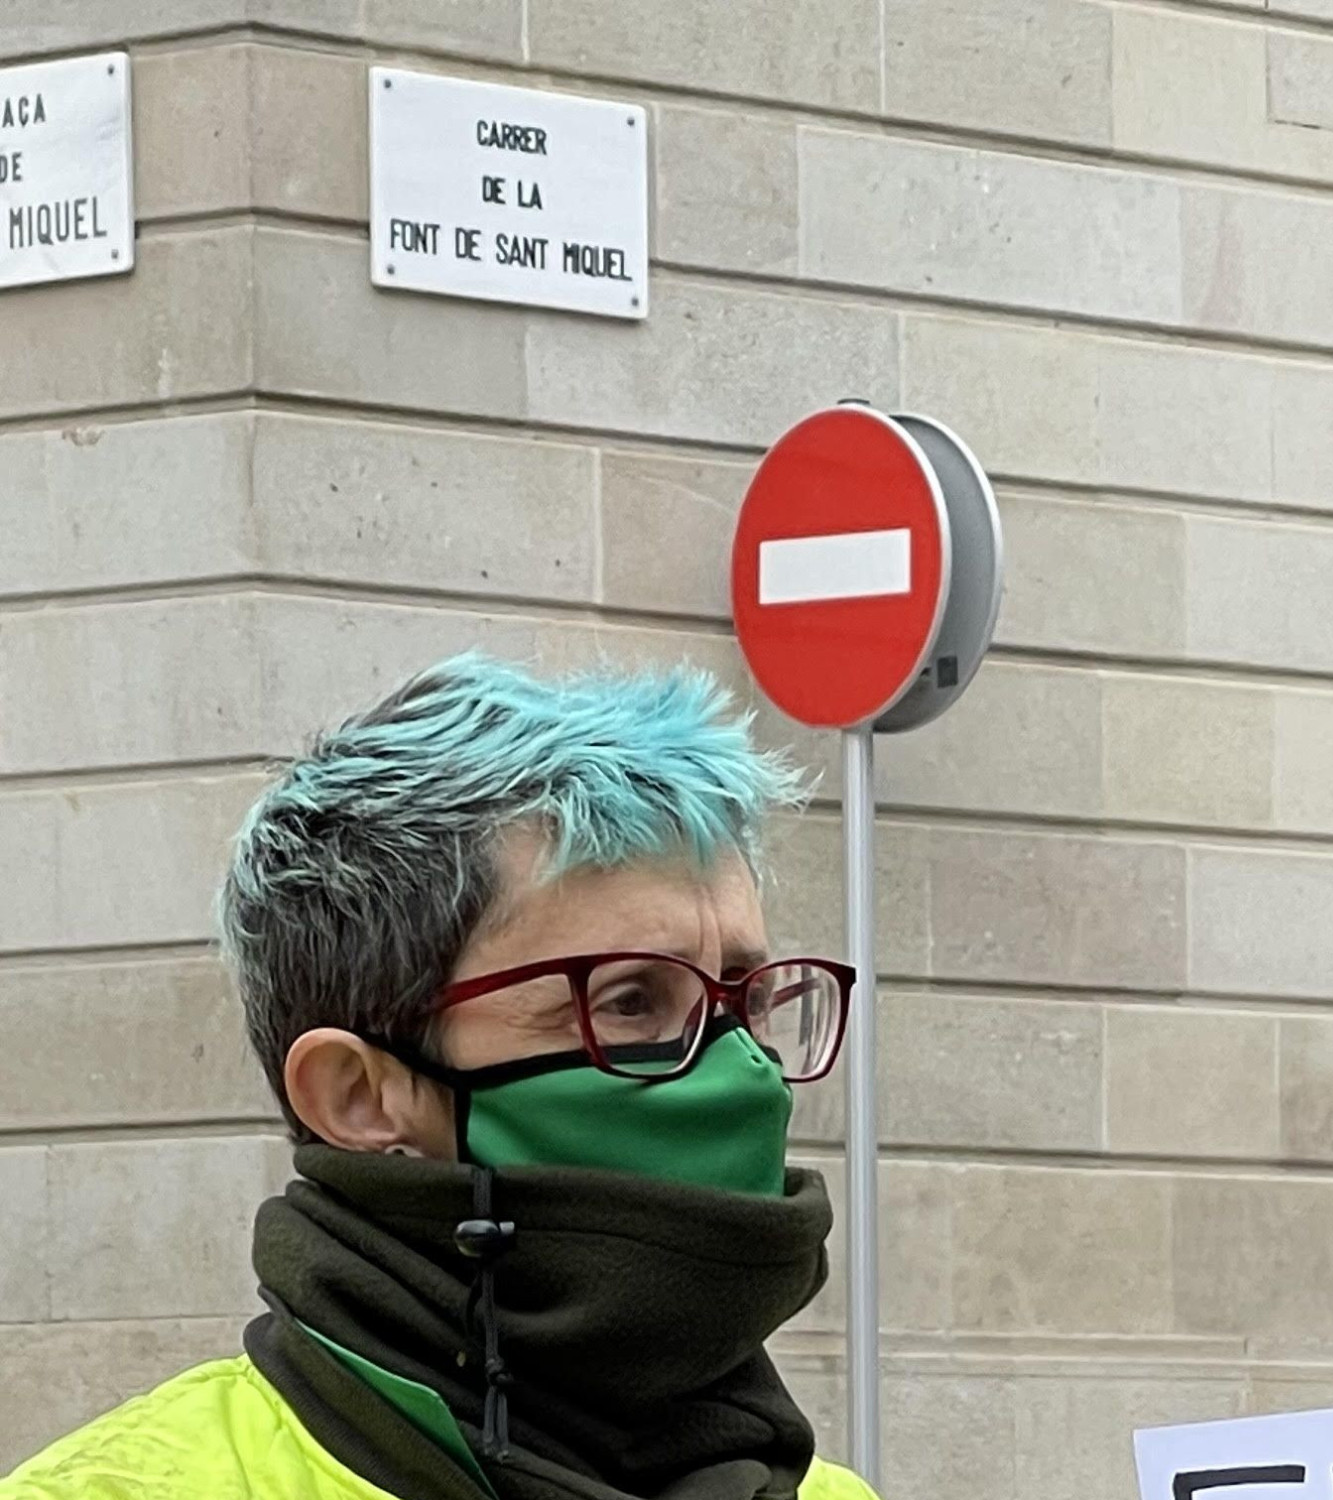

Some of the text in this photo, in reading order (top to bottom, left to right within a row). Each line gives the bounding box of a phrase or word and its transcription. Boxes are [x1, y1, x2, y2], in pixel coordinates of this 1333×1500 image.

[476, 119, 547, 155] CARRER
[482, 175, 543, 210] DE LA
[9, 197, 107, 249] MIQUEL
[390, 218, 633, 282] FONT DE SANT MIQUEL
